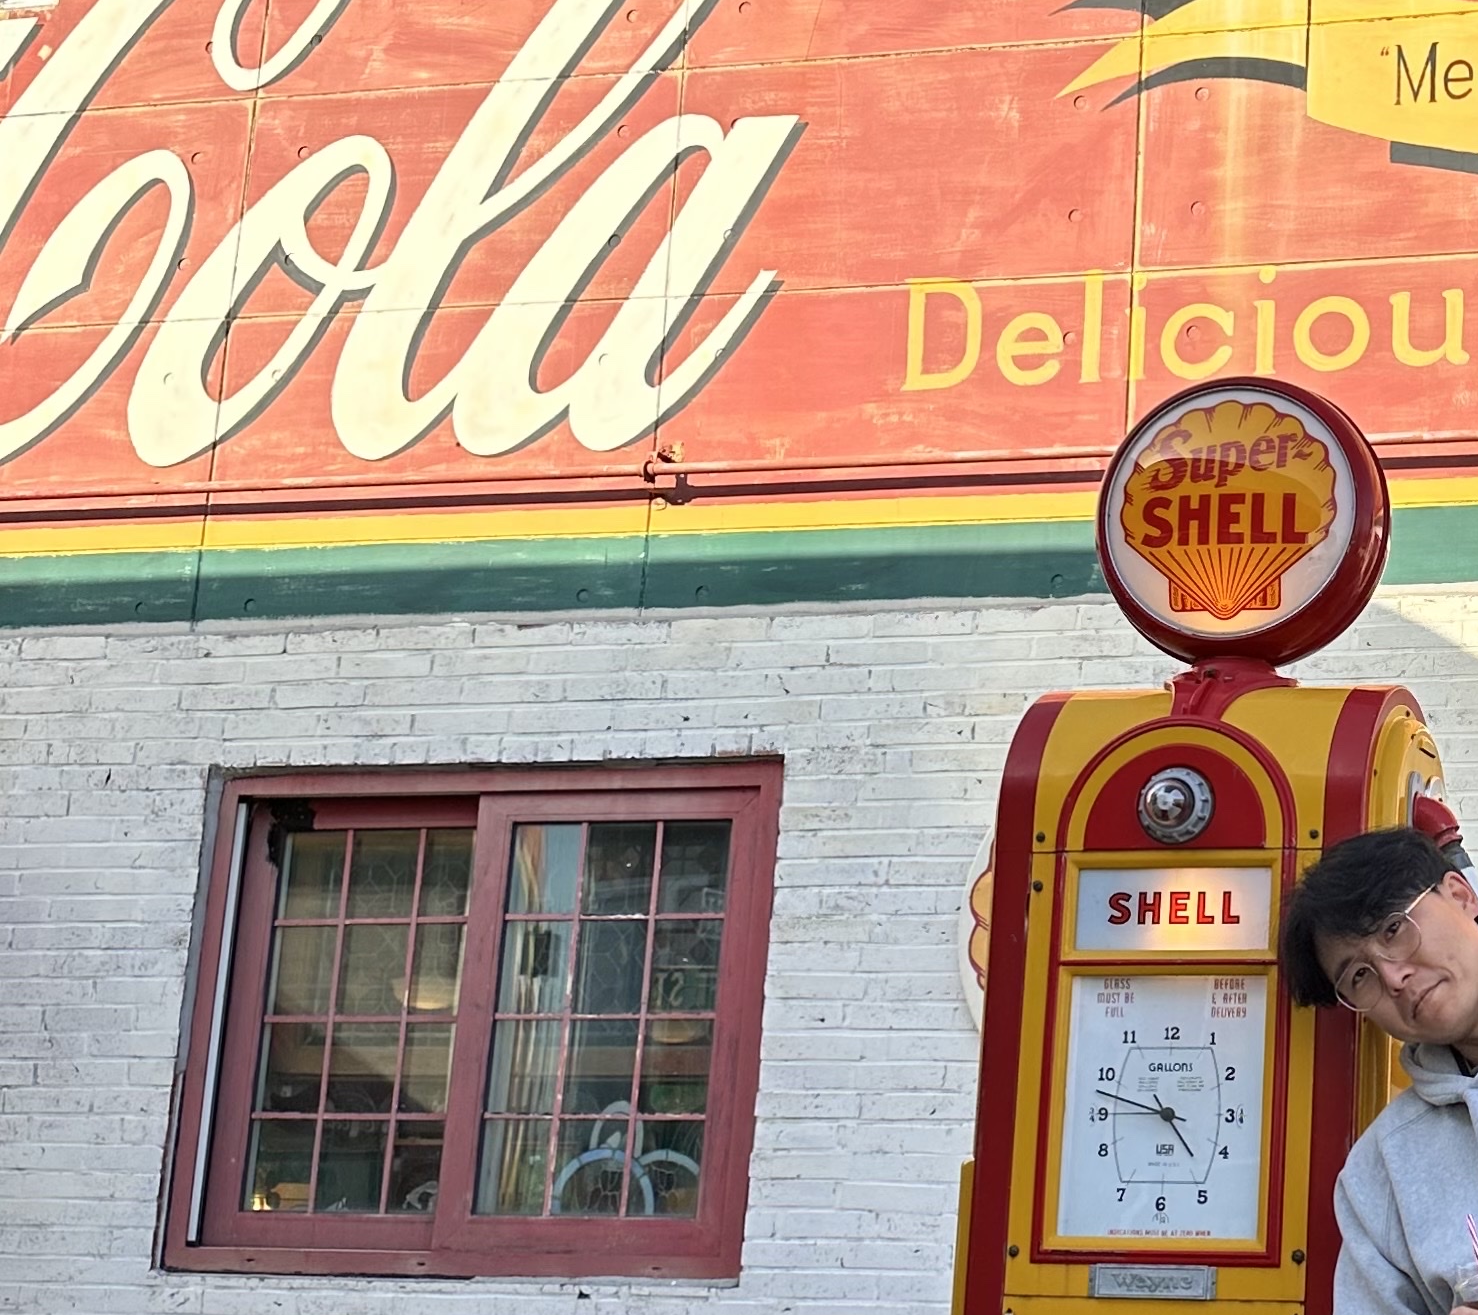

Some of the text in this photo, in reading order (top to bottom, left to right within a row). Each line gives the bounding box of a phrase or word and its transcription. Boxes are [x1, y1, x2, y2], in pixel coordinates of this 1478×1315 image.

[1140, 492, 1309, 549] SHELL
[1107, 890, 1241, 926] SHELL
[1104, 977, 1131, 990] GLASS
[1097, 992, 1135, 1004] MUST BE
[1121, 1030, 1137, 1045] 11
[1163, 1026, 1181, 1041] 12
[1209, 1032, 1217, 1046] 1
[1097, 1067, 1116, 1082] 10
[1148, 1062, 1194, 1072] GALLONS
[1224, 1066, 1236, 1081] 2
[1098, 1106, 1108, 1121] 9
[1224, 1107, 1236, 1124] 3
[1097, 1143, 1109, 1158] 8
[1218, 1145, 1230, 1160] 4
[1116, 1187, 1127, 1202] 7
[1196, 1189, 1209, 1205] 5
[1155, 1196, 1167, 1212] 6
